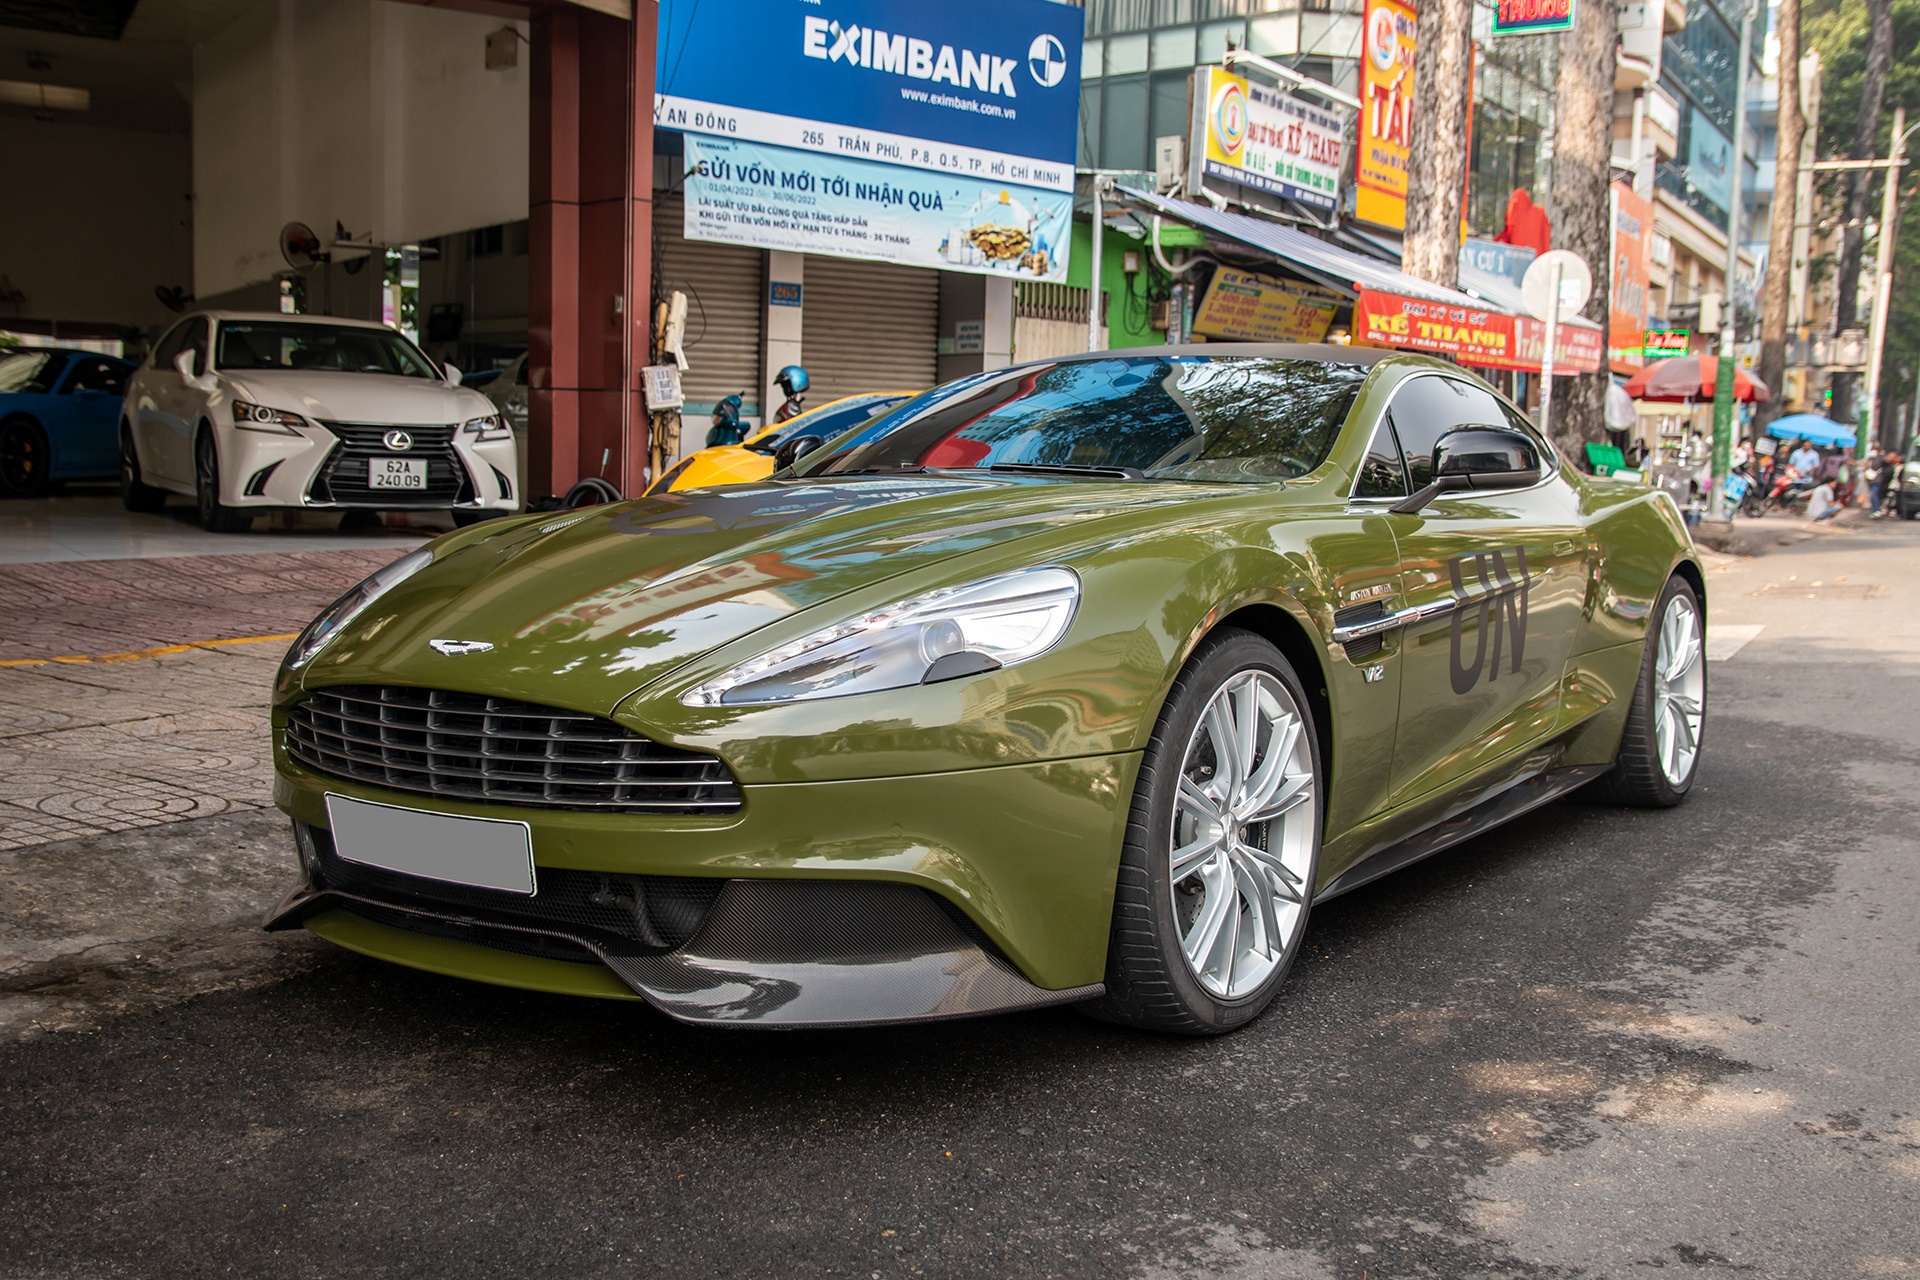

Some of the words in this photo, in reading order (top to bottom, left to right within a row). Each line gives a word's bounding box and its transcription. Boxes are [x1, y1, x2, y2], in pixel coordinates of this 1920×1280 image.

[804, 15, 1018, 98] EXIMBANK
[901, 87, 1016, 120] www.eximbank.com.vn
[668, 108, 687, 124] AN
[695, 111, 737, 132] ĐÔNG
[802, 130, 824, 146] 265
[911, 148, 934, 165] P.8,
[939, 153, 963, 170] Q.5,
[968, 158, 985, 173] TP.
[1010, 163, 1029, 179] CHÍ
[1033, 169, 1061, 184] MINH
[698, 155, 730, 180] GỬI
[736, 161, 775, 186] VỐN
[781, 170, 815, 192] MỚI
[820, 175, 849, 197] TỚI
[855, 182, 903, 208] NHẬN
[908, 190, 943, 212] QUÀ
[708, 182, 755, 197] 01/04/2022
[773, 191, 817, 206] 30/06/2022
[699, 209, 714, 219] KHI
[713, 198, 735, 209] SUẤT
[767, 205, 790, 217] CÙNG
[792, 209, 810, 220] QUÀ
[775, 285, 798, 299] 265
[1402, 301, 1427, 317] ĐẠI
[1429, 305, 1447, 320] LÝ
[1449, 309, 1466, 323] VÉ
[1468, 311, 1489, 326] SỐ
[1369, 312, 1410, 336] KẾ
[1416, 320, 1507, 348] THANH
[1389, 334, 1409, 344] 267
[386, 461, 411, 473] 62A
[377, 474, 420, 487] 240.09
[1448, 545, 1530, 695] UN
